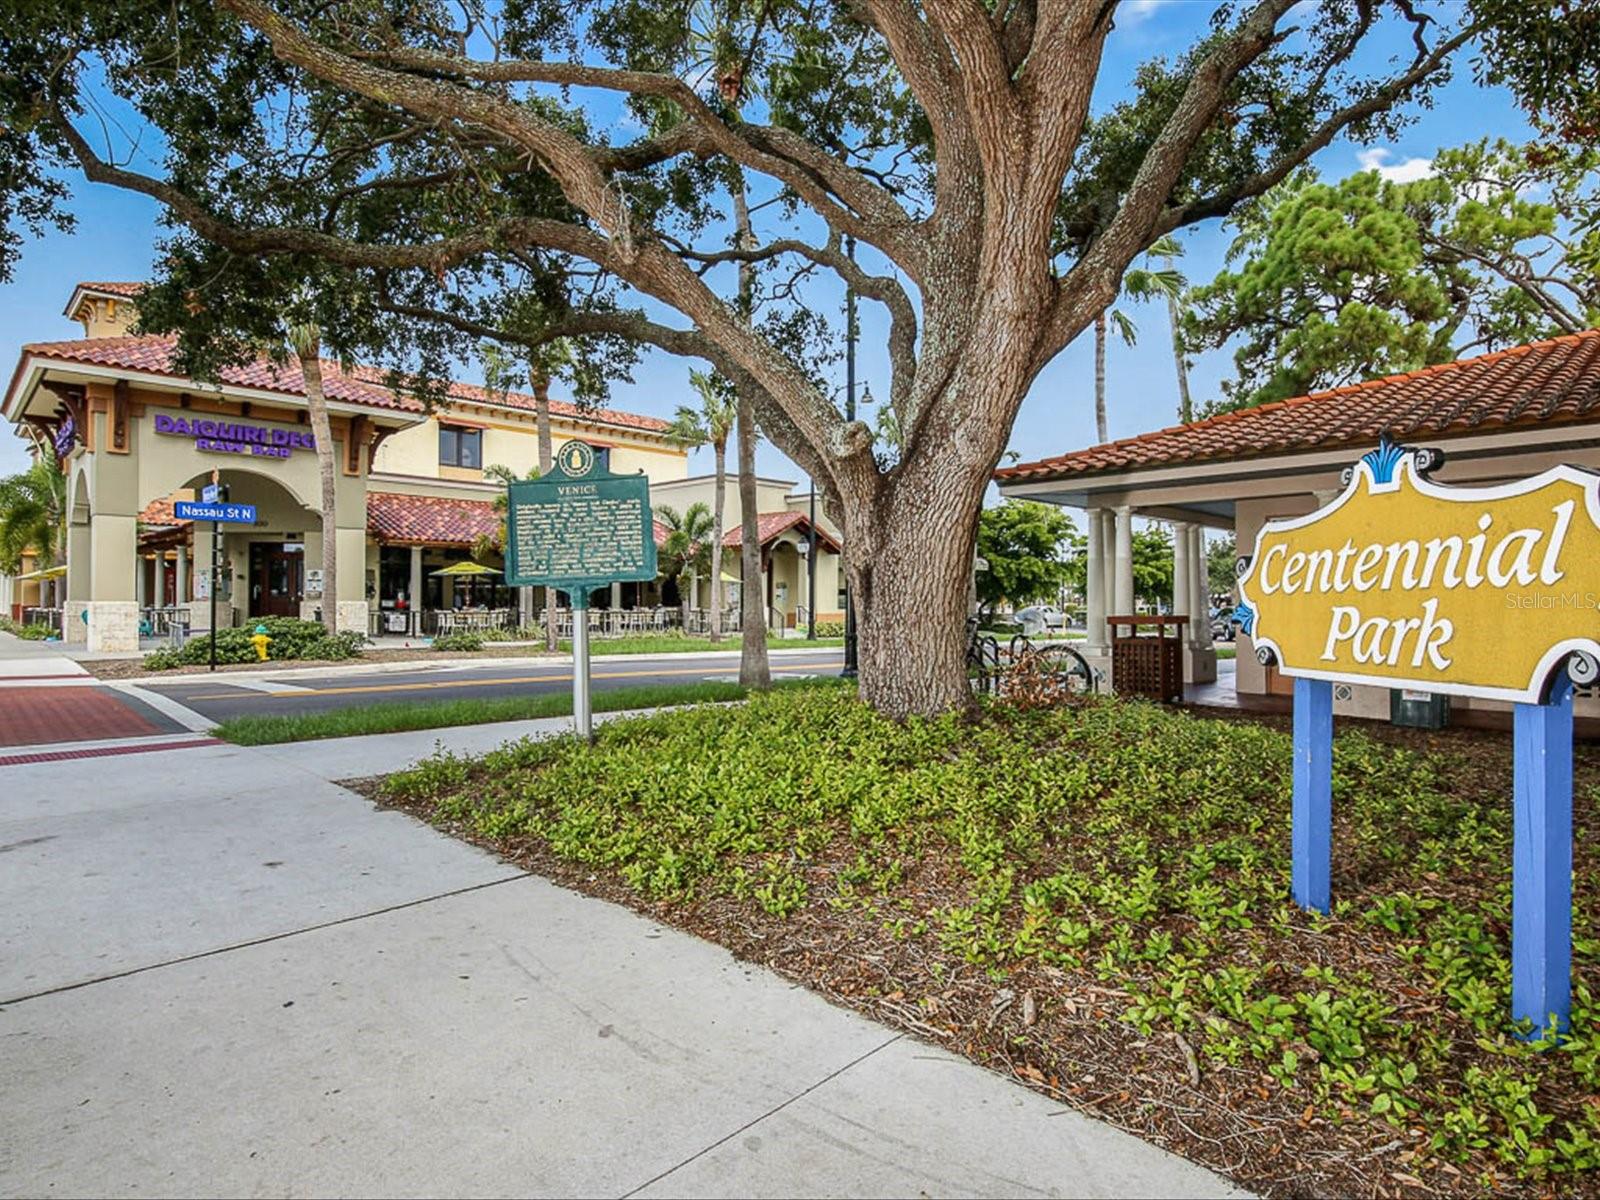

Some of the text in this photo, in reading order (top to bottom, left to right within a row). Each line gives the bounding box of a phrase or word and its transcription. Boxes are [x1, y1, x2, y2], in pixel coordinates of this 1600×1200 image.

[155, 413, 316, 449] DAIQUIRI DEC
[195, 438, 291, 458] RAW BAR
[558, 485, 598, 495] VENICE
[181, 506, 251, 519] Nassau St N
[1259, 499, 1576, 596] Centennial
[1320, 598, 1456, 671] Park
